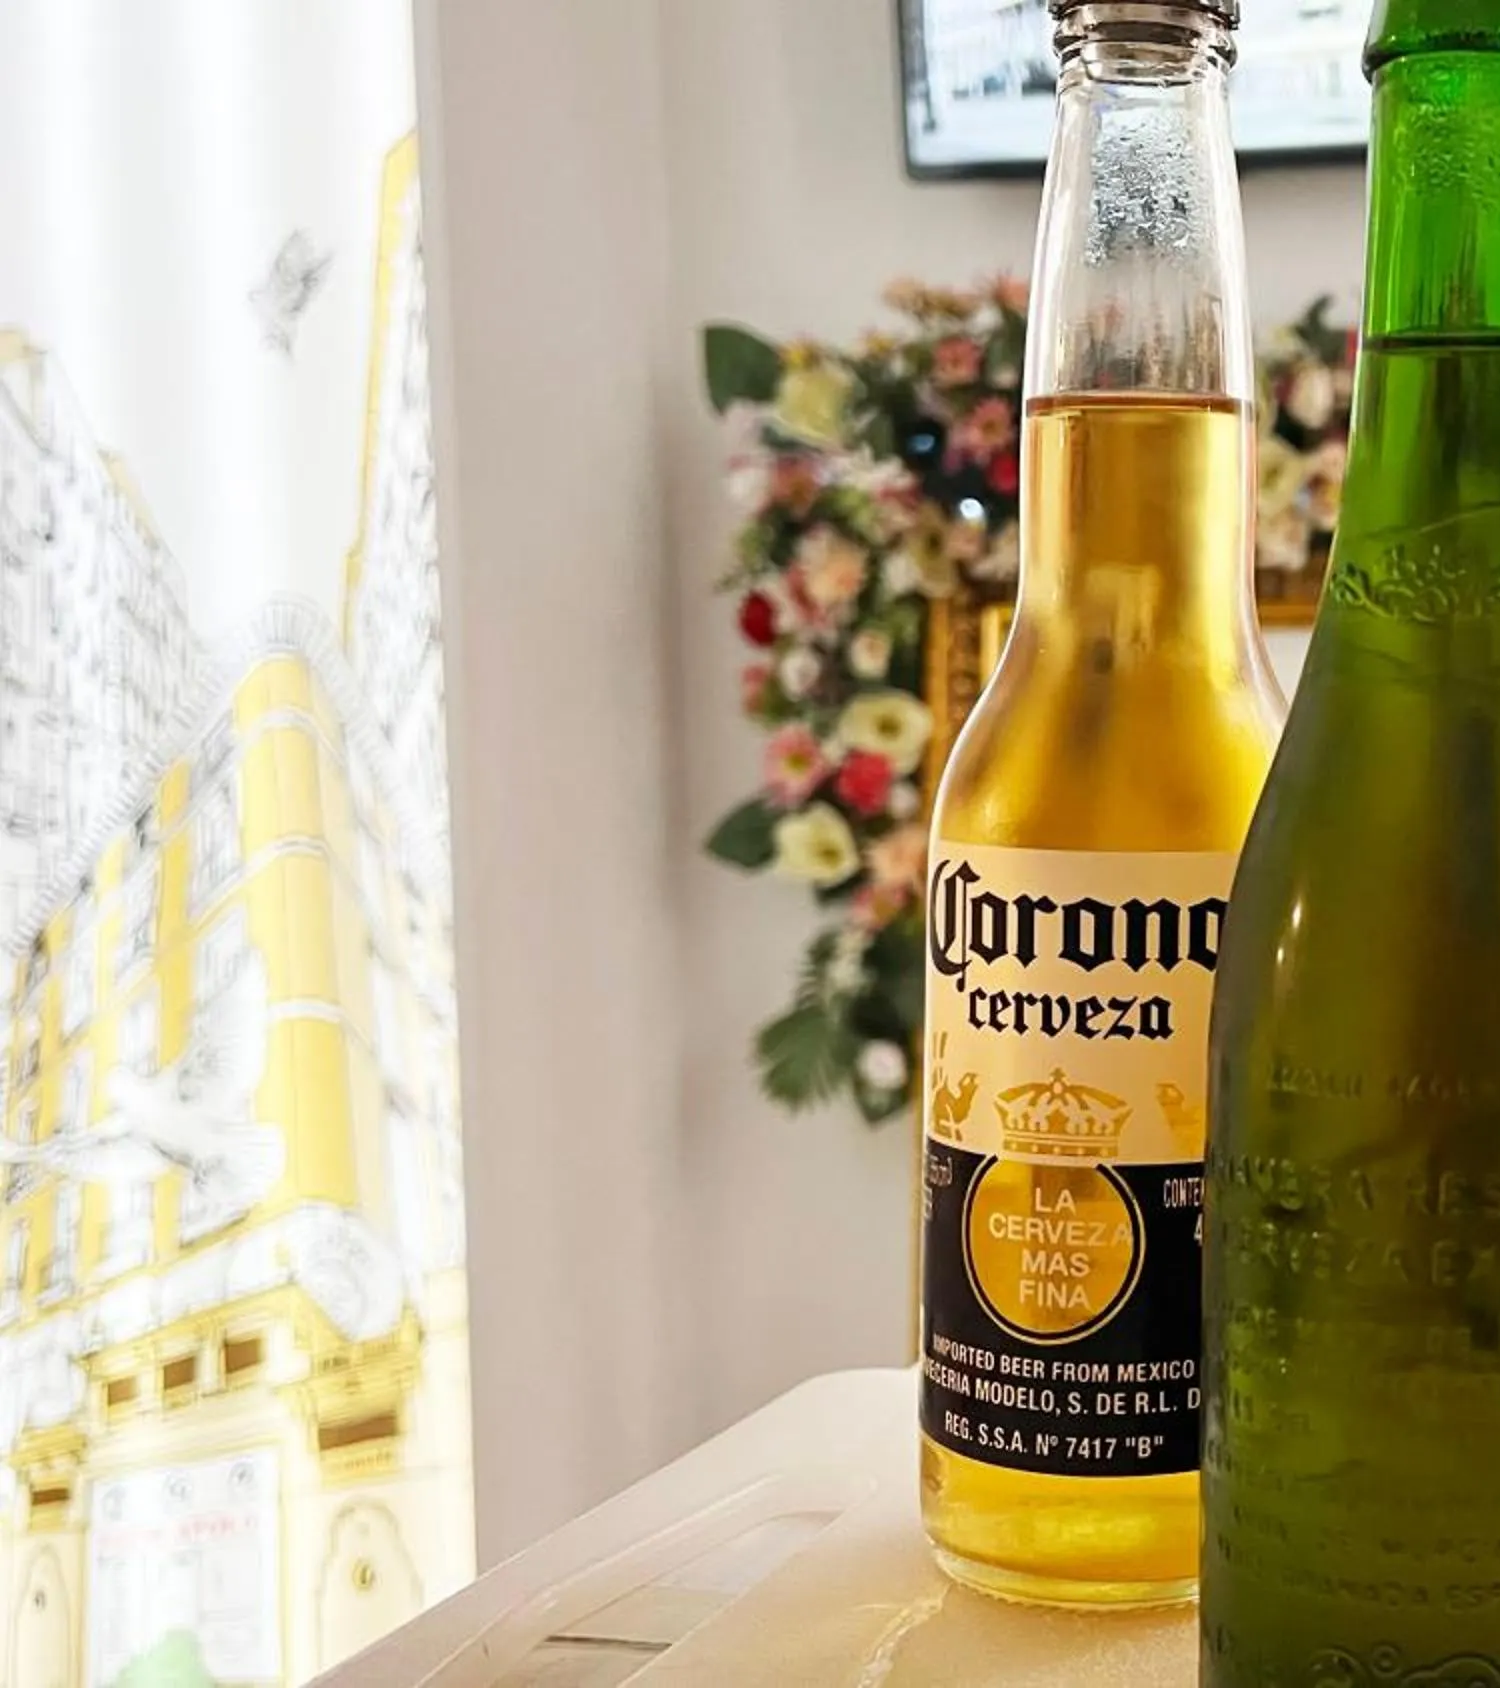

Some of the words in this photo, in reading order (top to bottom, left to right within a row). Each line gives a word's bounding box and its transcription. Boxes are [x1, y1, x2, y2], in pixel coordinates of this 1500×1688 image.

[967, 986, 1174, 1041] cerveza
[1033, 1187, 1077, 1215] LA
[988, 1213, 1133, 1247] CERVEZA
[1021, 1249, 1091, 1279] MAS
[1018, 1281, 1091, 1311] FINA
[933, 1333, 995, 1371] IMPORTED
[1000, 1354, 1045, 1380] BEER
[1051, 1361, 1110, 1383] FROM
[1117, 1358, 1195, 1383] MEXICO
[975, 1377, 1061, 1418] MODELO,
[1067, 1391, 1089, 1416] S.
[1095, 1392, 1127, 1416] DE
[1135, 1390, 1178, 1414] R.L.
[944, 1409, 974, 1442] REG.
[977, 1423, 1028, 1454] S.S.A.
[1065, 1437, 1118, 1460] 7417
